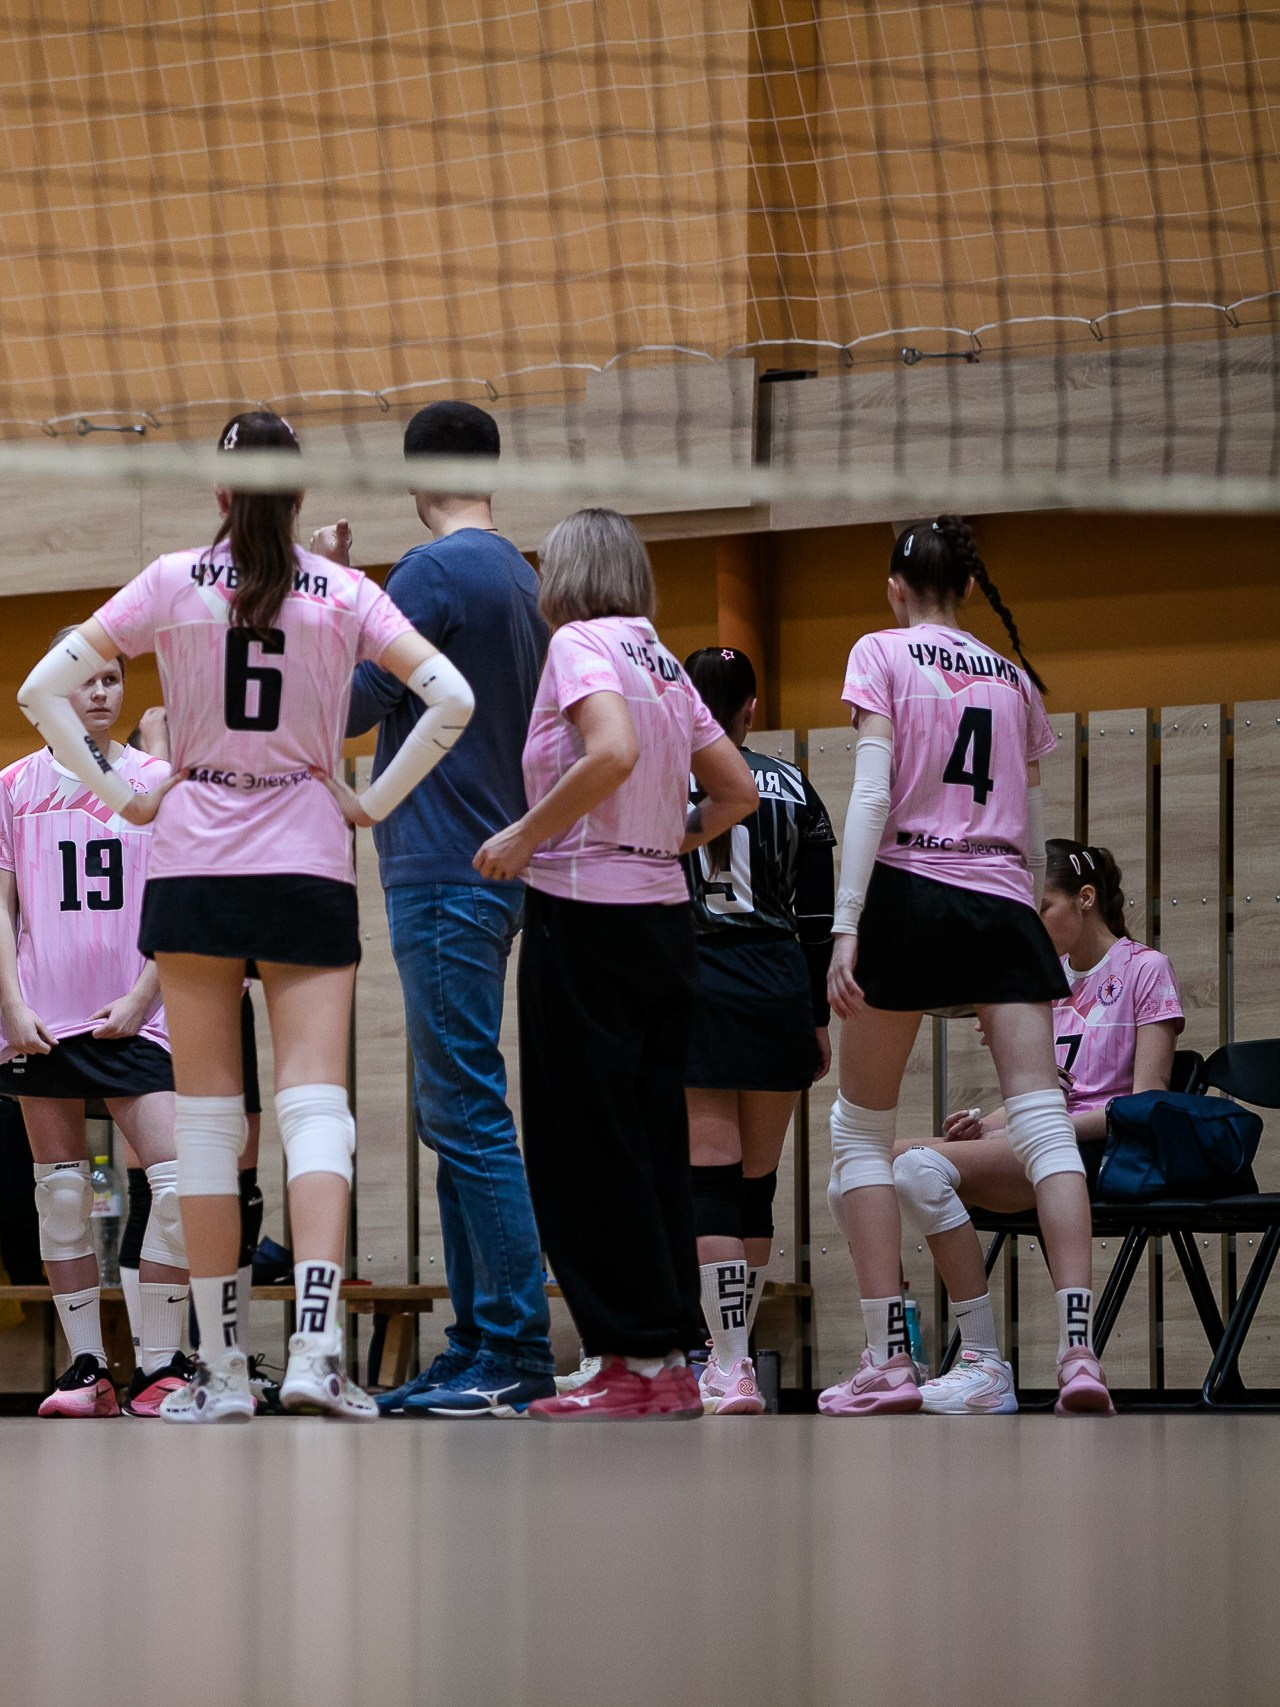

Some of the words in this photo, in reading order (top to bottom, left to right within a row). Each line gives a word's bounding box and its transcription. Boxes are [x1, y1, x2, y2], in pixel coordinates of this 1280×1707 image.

[190, 563, 328, 598] ЧУВИЯ
[224, 627, 286, 732] 6
[907, 643, 1021, 687] ЧУВАШИЯ
[942, 706, 994, 806] 4
[912, 834, 954, 851] АБС
[58, 838, 124, 911] 19
[1055, 1033, 1083, 1069] 7
